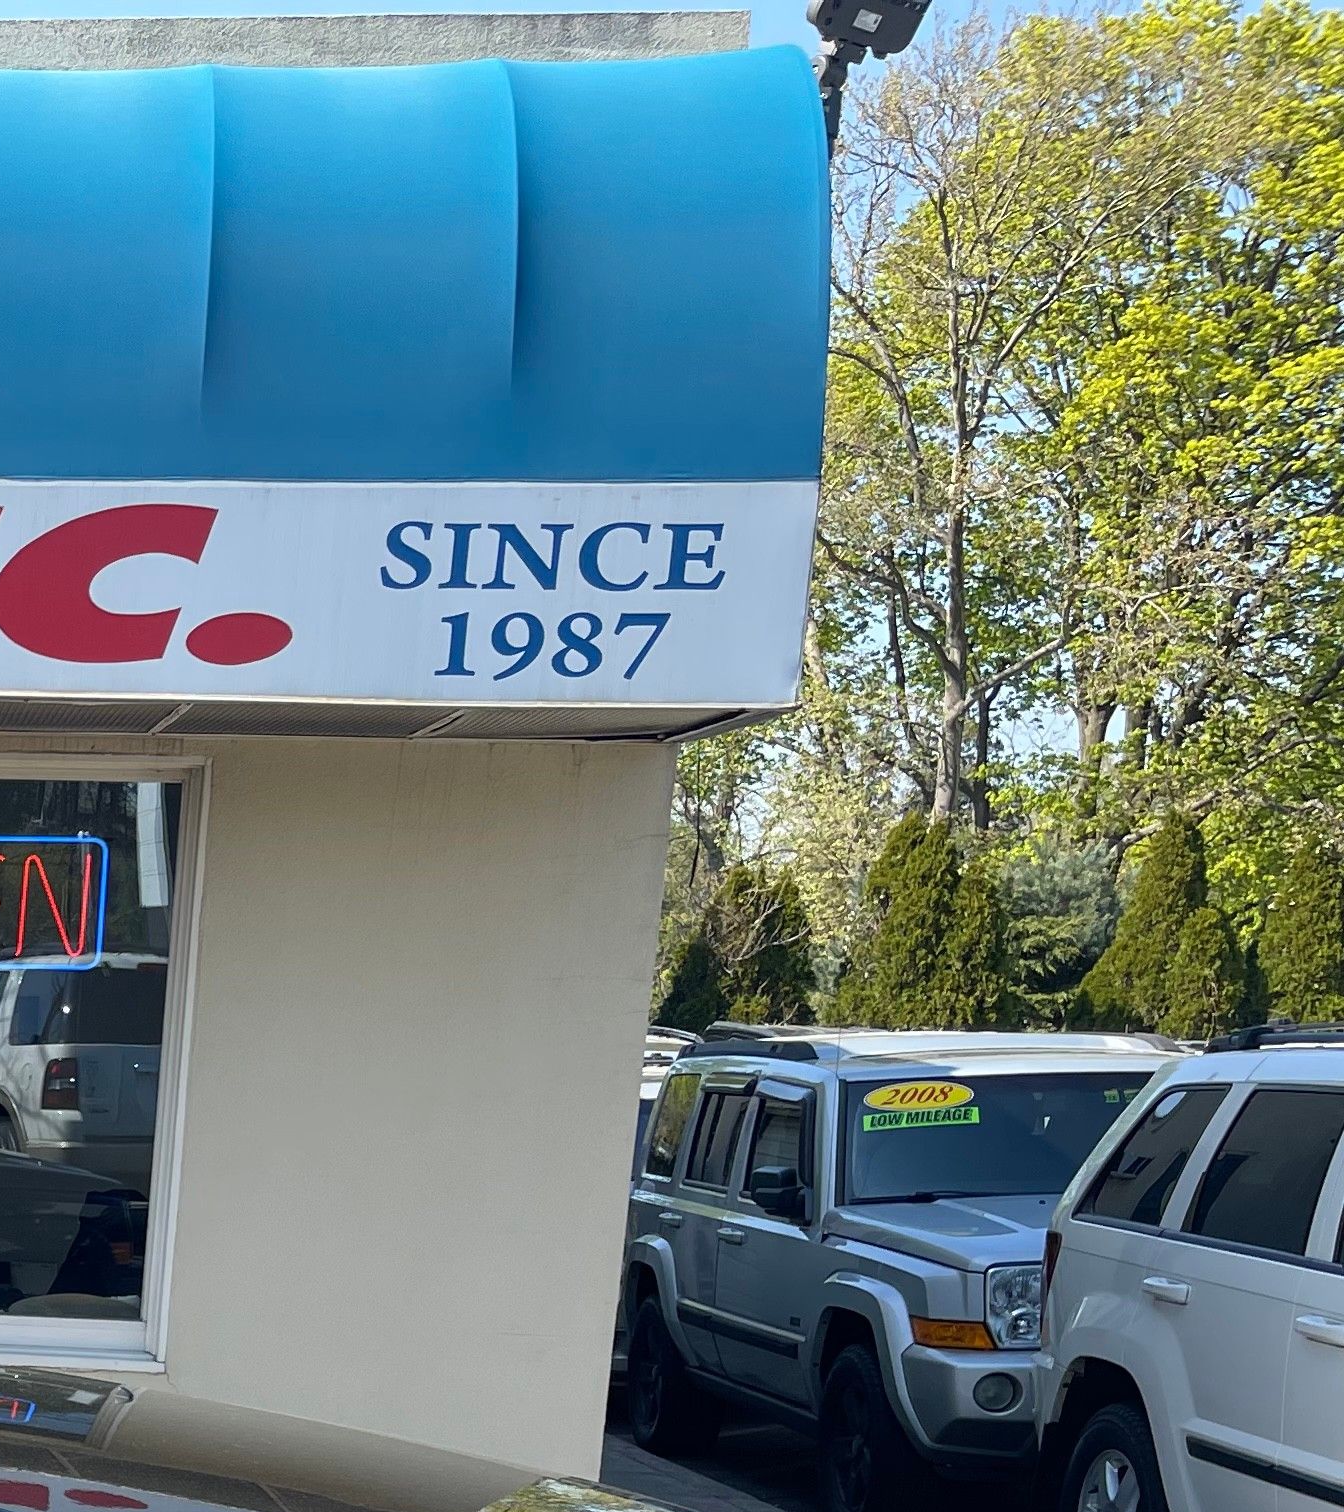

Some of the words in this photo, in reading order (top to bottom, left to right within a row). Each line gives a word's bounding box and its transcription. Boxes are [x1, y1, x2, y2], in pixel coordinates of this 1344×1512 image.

[380, 520, 726, 592] SINCE
[434, 611, 672, 681] 1987
[869, 1112, 904, 1128] LOW
[905, 1108, 974, 1125] MILEAGE
[880, 1085, 954, 1106] 2008
